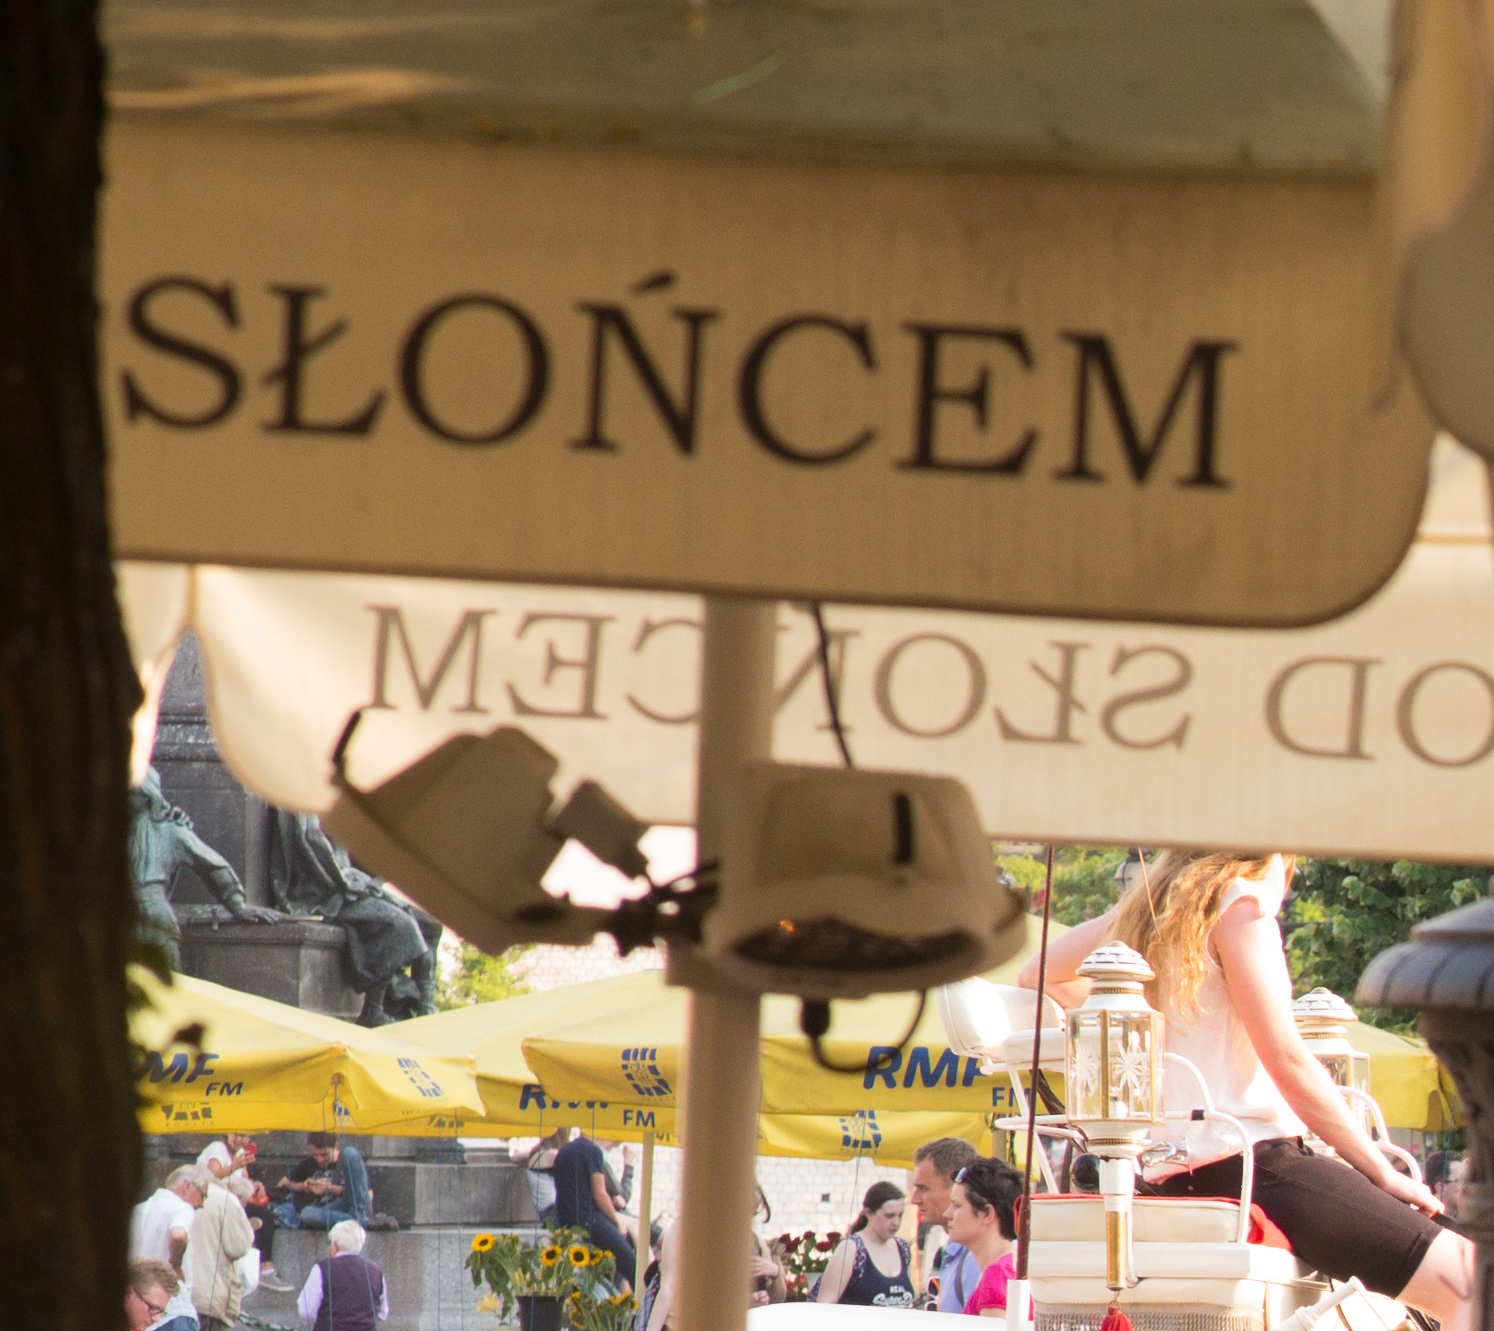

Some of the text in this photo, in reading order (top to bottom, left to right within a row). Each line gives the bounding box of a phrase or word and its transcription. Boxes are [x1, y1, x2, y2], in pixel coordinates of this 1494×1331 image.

[121, 272, 1238, 489] SŁOŃCEM
[205, 1082, 243, 1097] FM
[623, 1110, 656, 1128] FM
